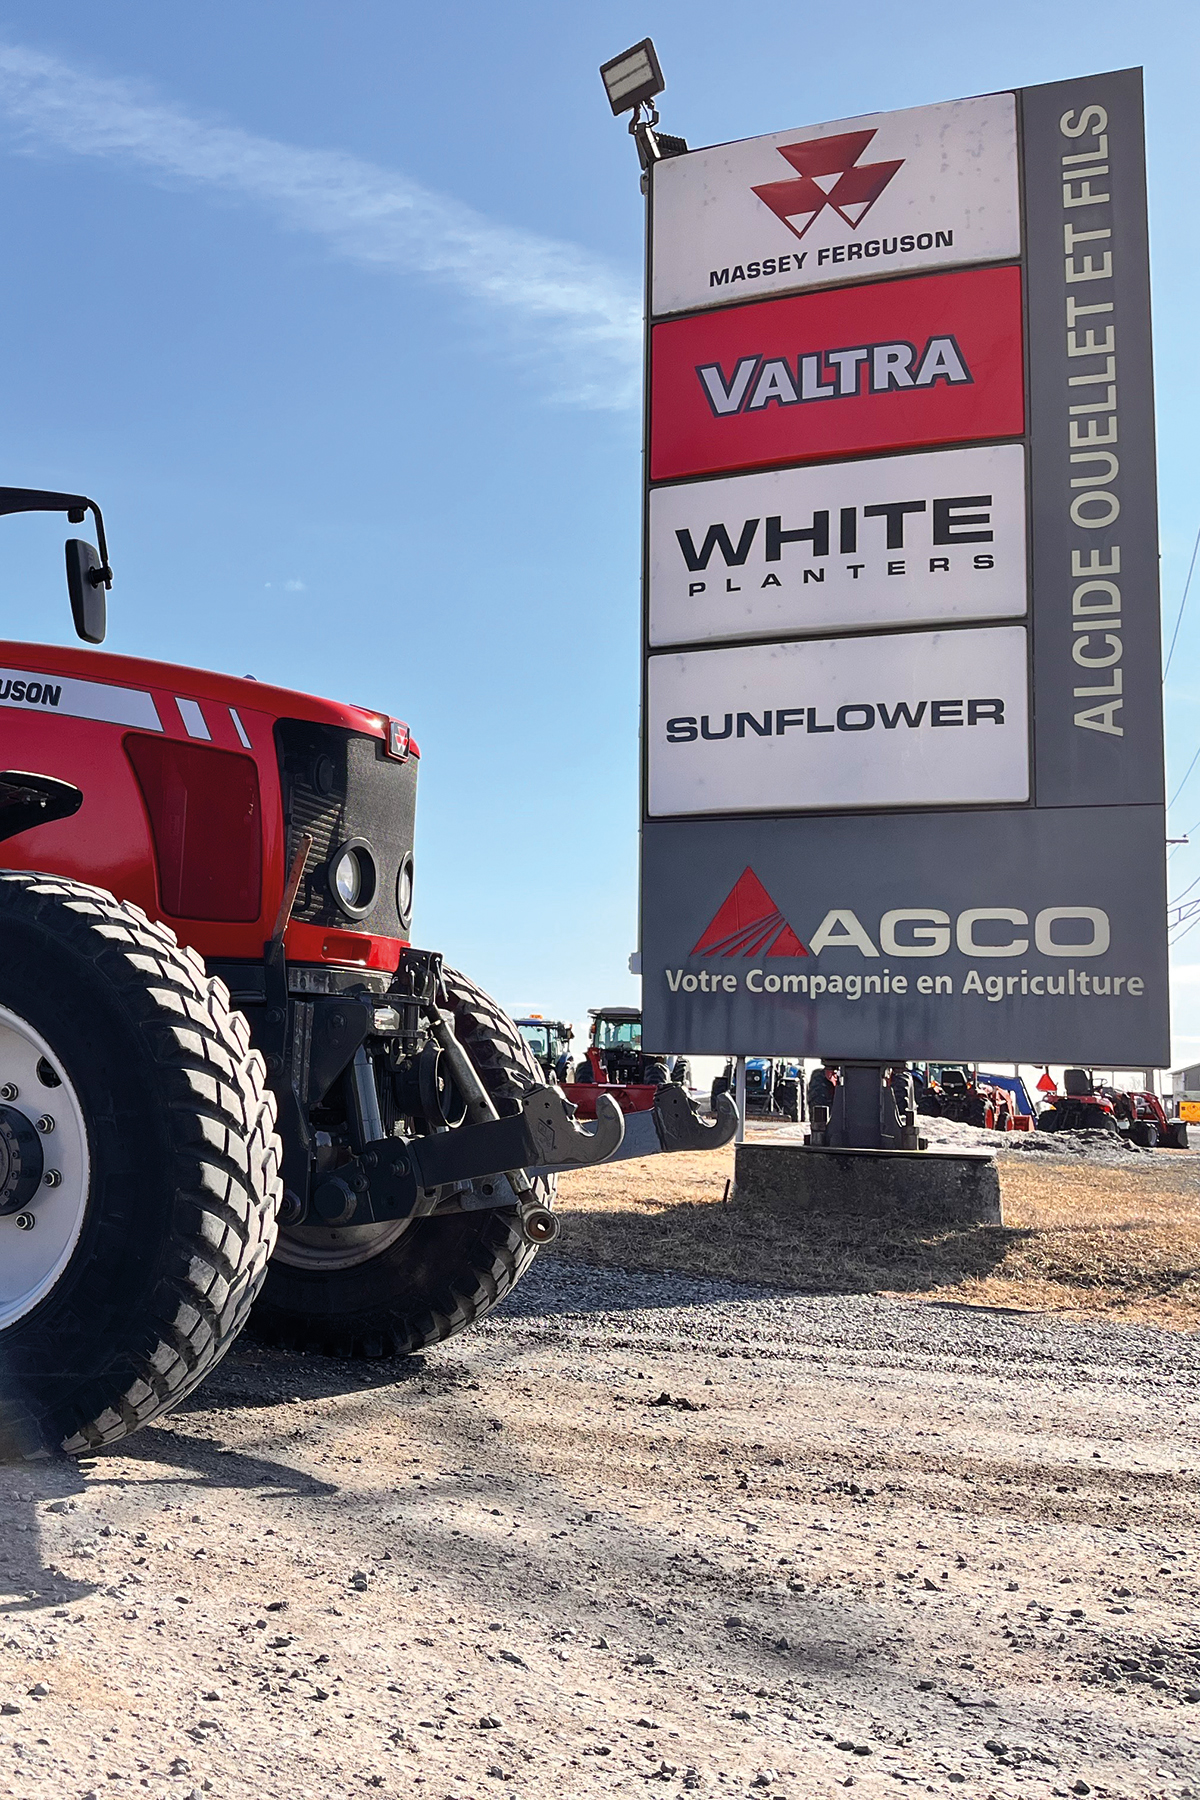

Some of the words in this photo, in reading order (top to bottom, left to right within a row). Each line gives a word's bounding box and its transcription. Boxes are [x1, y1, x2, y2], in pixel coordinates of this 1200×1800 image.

[1059, 102, 1111, 209] FILS
[708, 252, 808, 288] MASSEY
[817, 229, 955, 267] FERGUSON
[1064, 222, 1114, 285] ET
[695, 334, 975, 418] VALTRA
[1066, 296, 1121, 530] OUELLET
[673, 494, 995, 573] WHITE
[688, 553, 995, 597] PLANTERS
[1072, 546, 1125, 738] ALCIDE
[664, 698, 1006, 743] SUNFLOWER
[807, 905, 1111, 958] AGCO
[665, 968, 737, 994] Votre
[745, 968, 908, 1000] Compagnie
[916, 975, 954, 995] en
[961, 969, 1145, 1002] Agriculture
